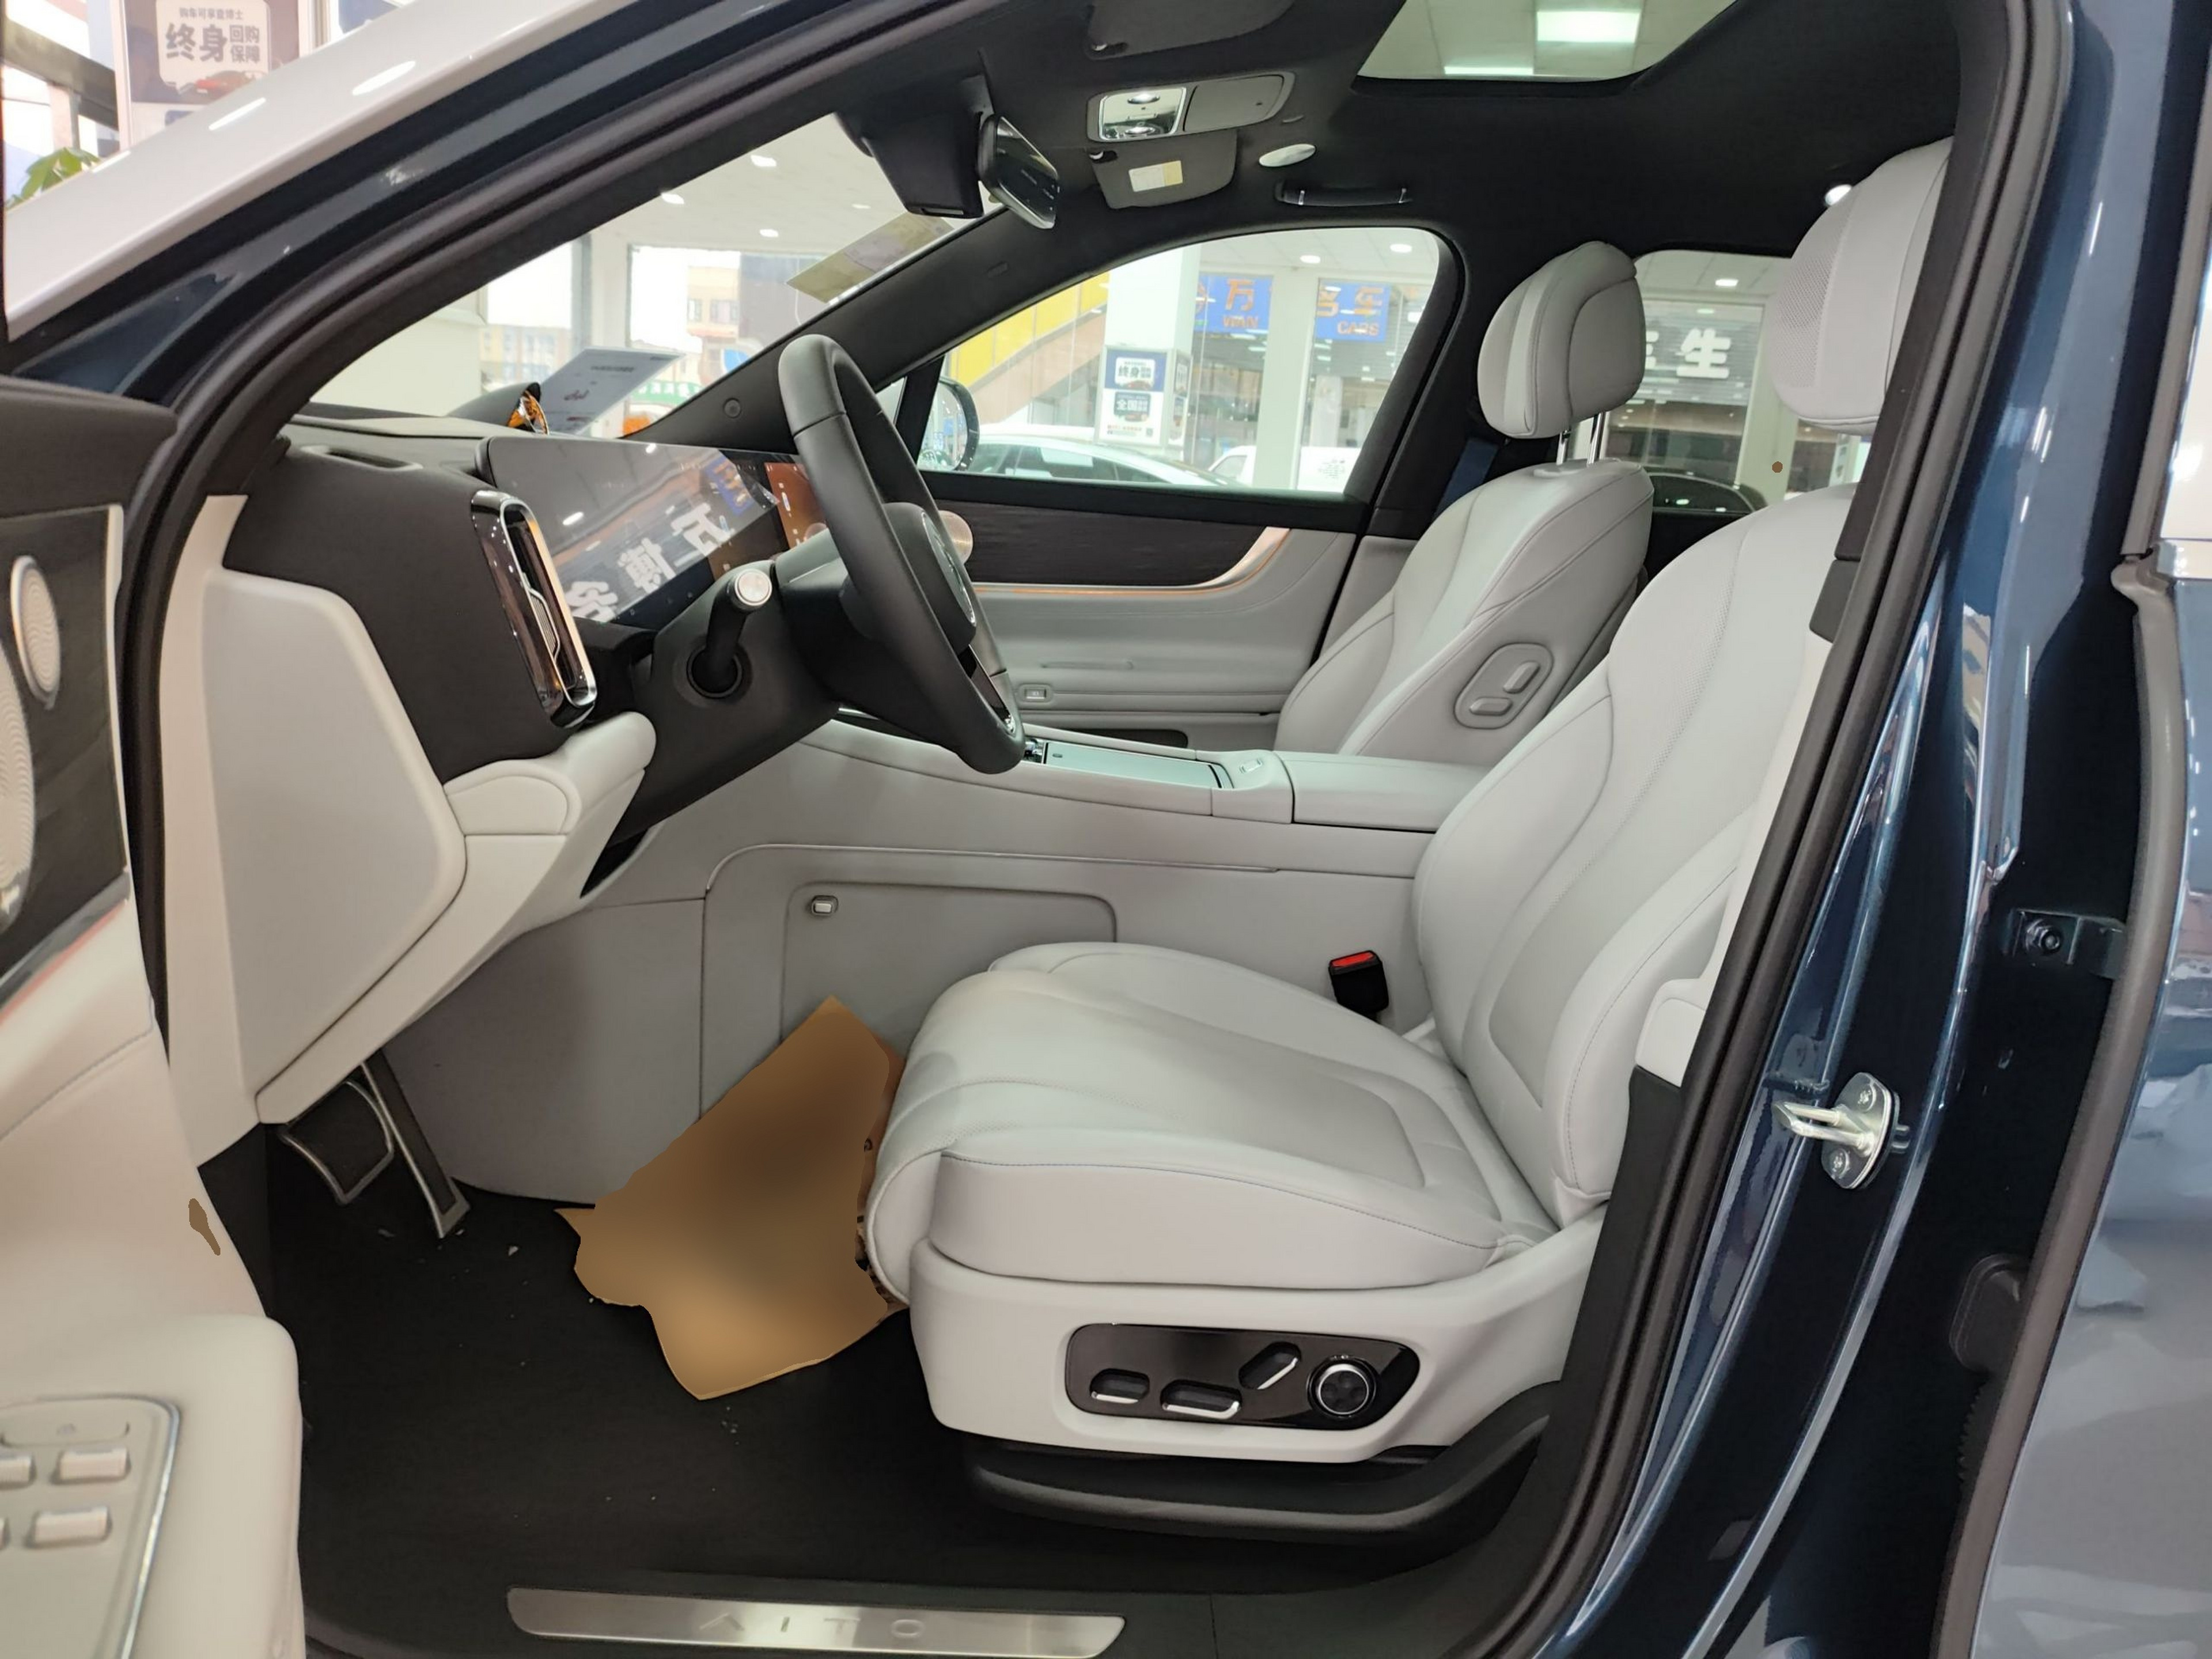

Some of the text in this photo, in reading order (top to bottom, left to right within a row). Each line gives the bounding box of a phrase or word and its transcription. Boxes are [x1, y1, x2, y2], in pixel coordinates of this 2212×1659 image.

[166, 23, 228, 62] 终身
[229, 24, 260, 43] 回购
[230, 45, 260, 63] 保障
[1225, 279, 1253, 311] 万
[1337, 321, 1379, 336] CARS
[1645, 328, 1732, 380] 生
[699, 1613, 925, 1639] AITO
